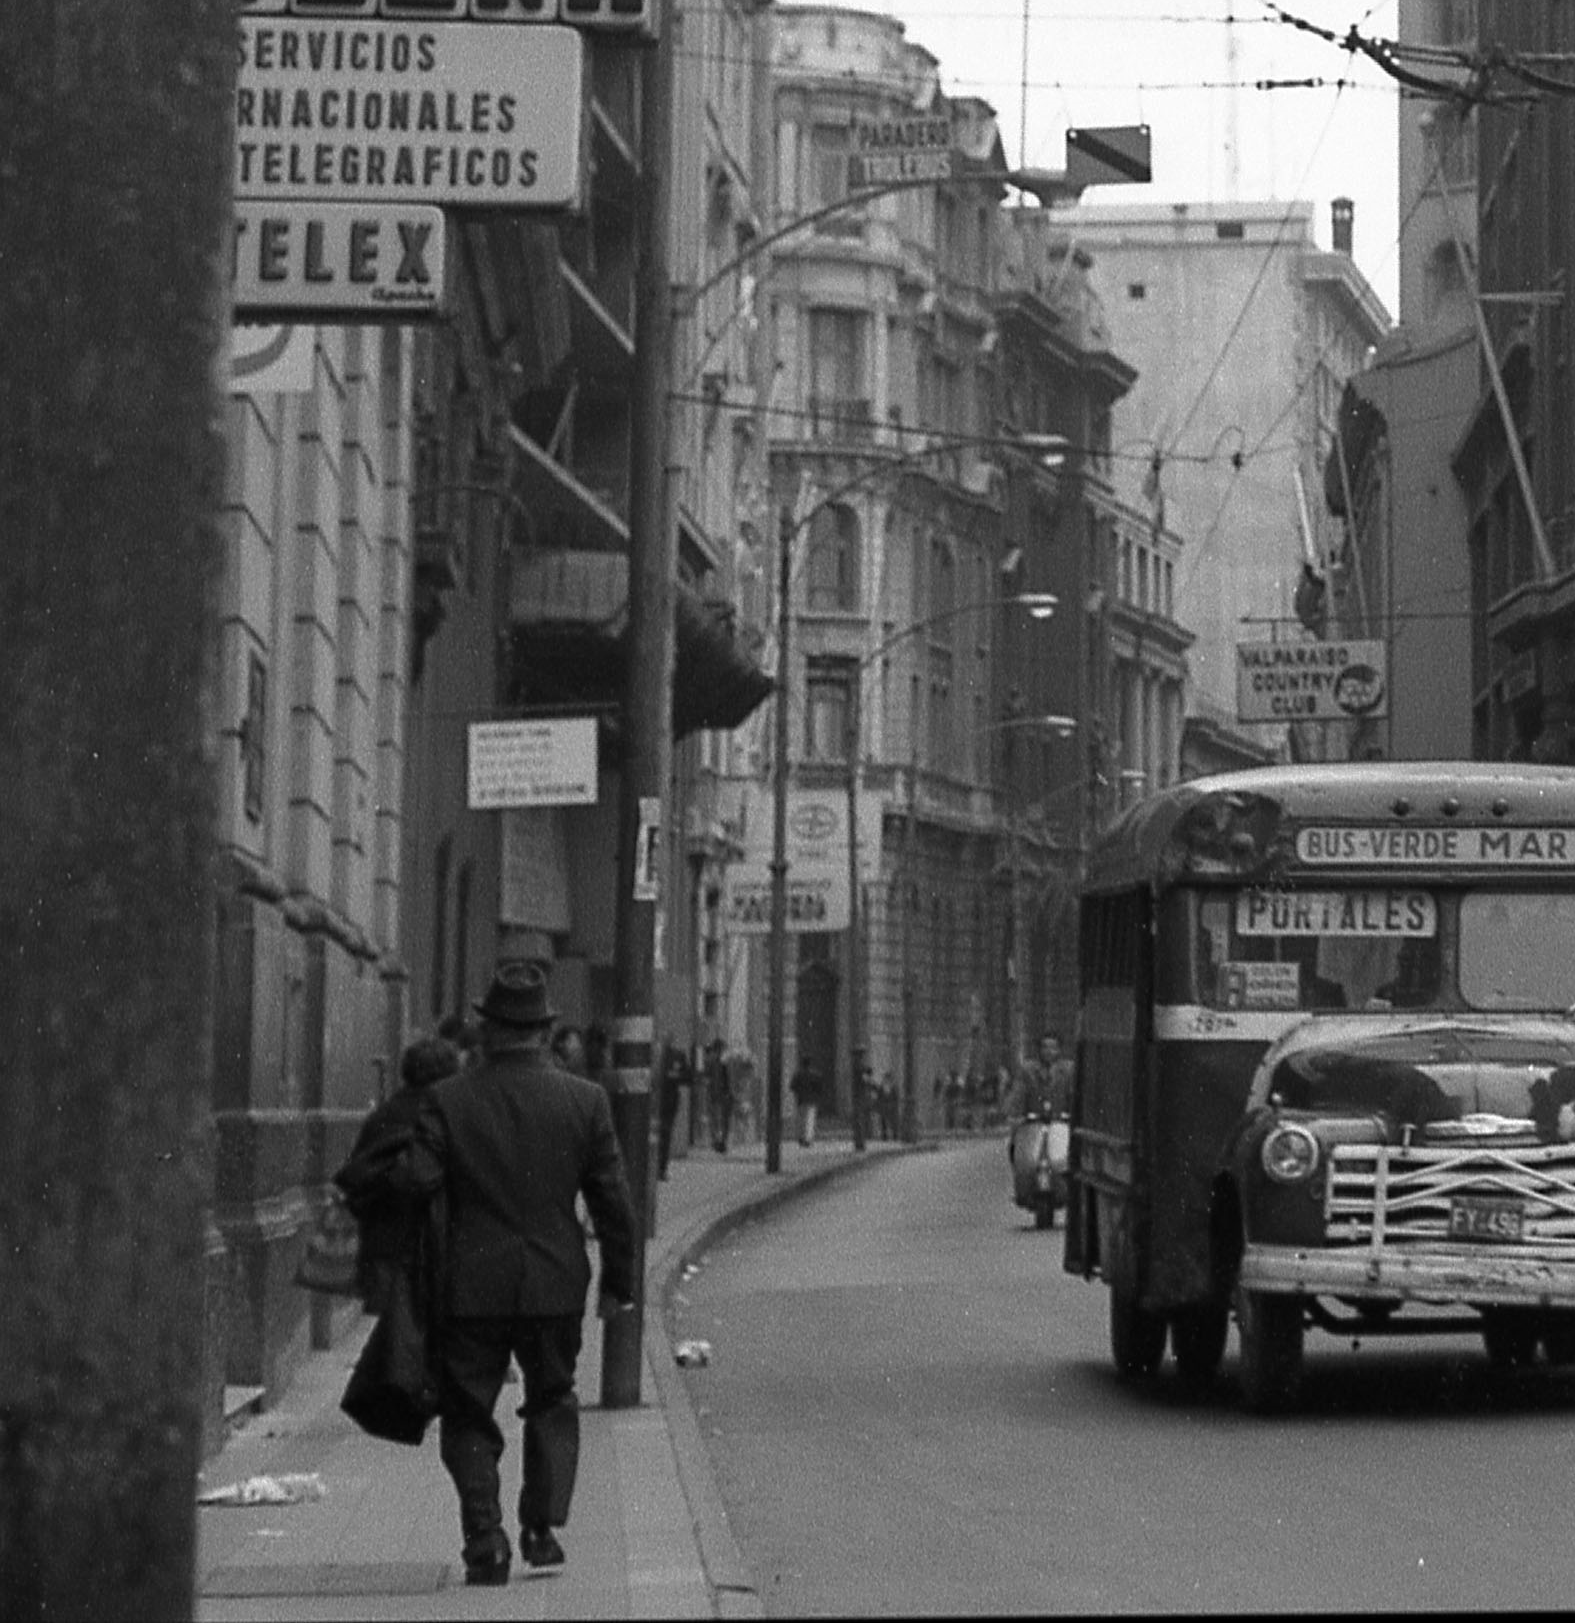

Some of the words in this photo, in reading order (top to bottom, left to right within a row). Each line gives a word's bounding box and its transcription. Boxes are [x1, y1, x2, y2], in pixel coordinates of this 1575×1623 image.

[240, 144, 538, 188] TELEGRAFICOS
[1253, 673, 1334, 692] COUNTRY
[1272, 695, 1316, 714] CLUB
[1307, 830, 1458, 859] BUS-VERDE
[1479, 831, 1568, 859] MAR
[1248, 895, 1425, 931] PORTALES
